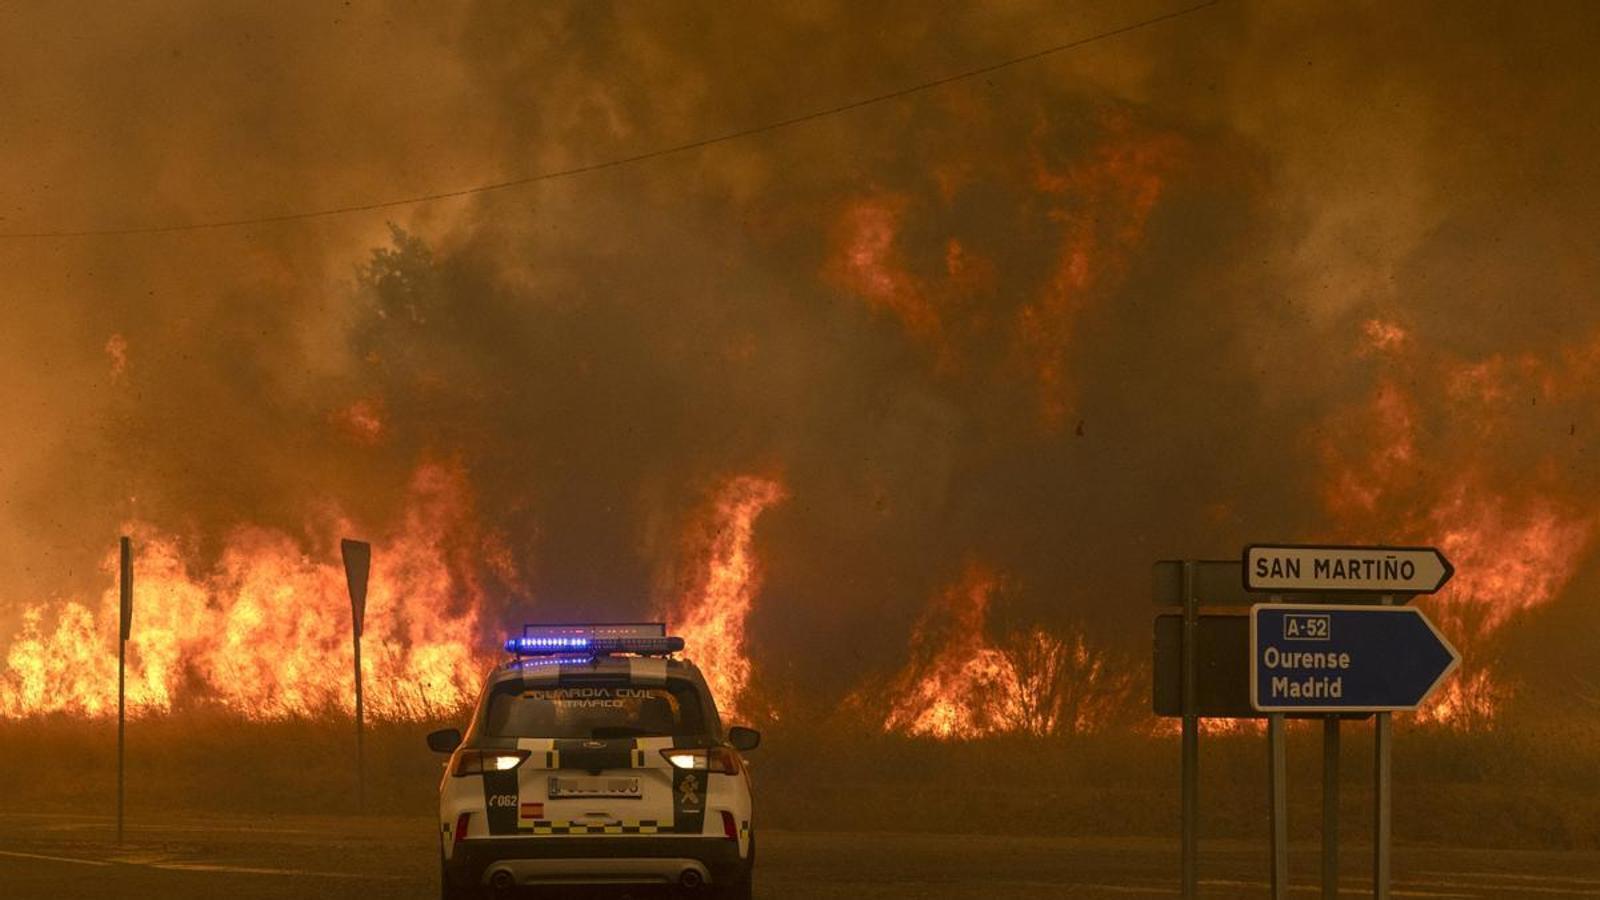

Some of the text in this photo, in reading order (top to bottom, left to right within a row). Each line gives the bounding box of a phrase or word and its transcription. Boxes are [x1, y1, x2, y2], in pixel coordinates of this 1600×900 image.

[1256, 555, 1415, 580] SAN MARTIÑO
[1287, 617, 1327, 636] A-52
[1264, 647, 1350, 669] Ourense
[533, 687, 656, 700] GUARDIA CIVIL
[1272, 676, 1342, 698] Madrid
[497, 795, 517, 807] 062
